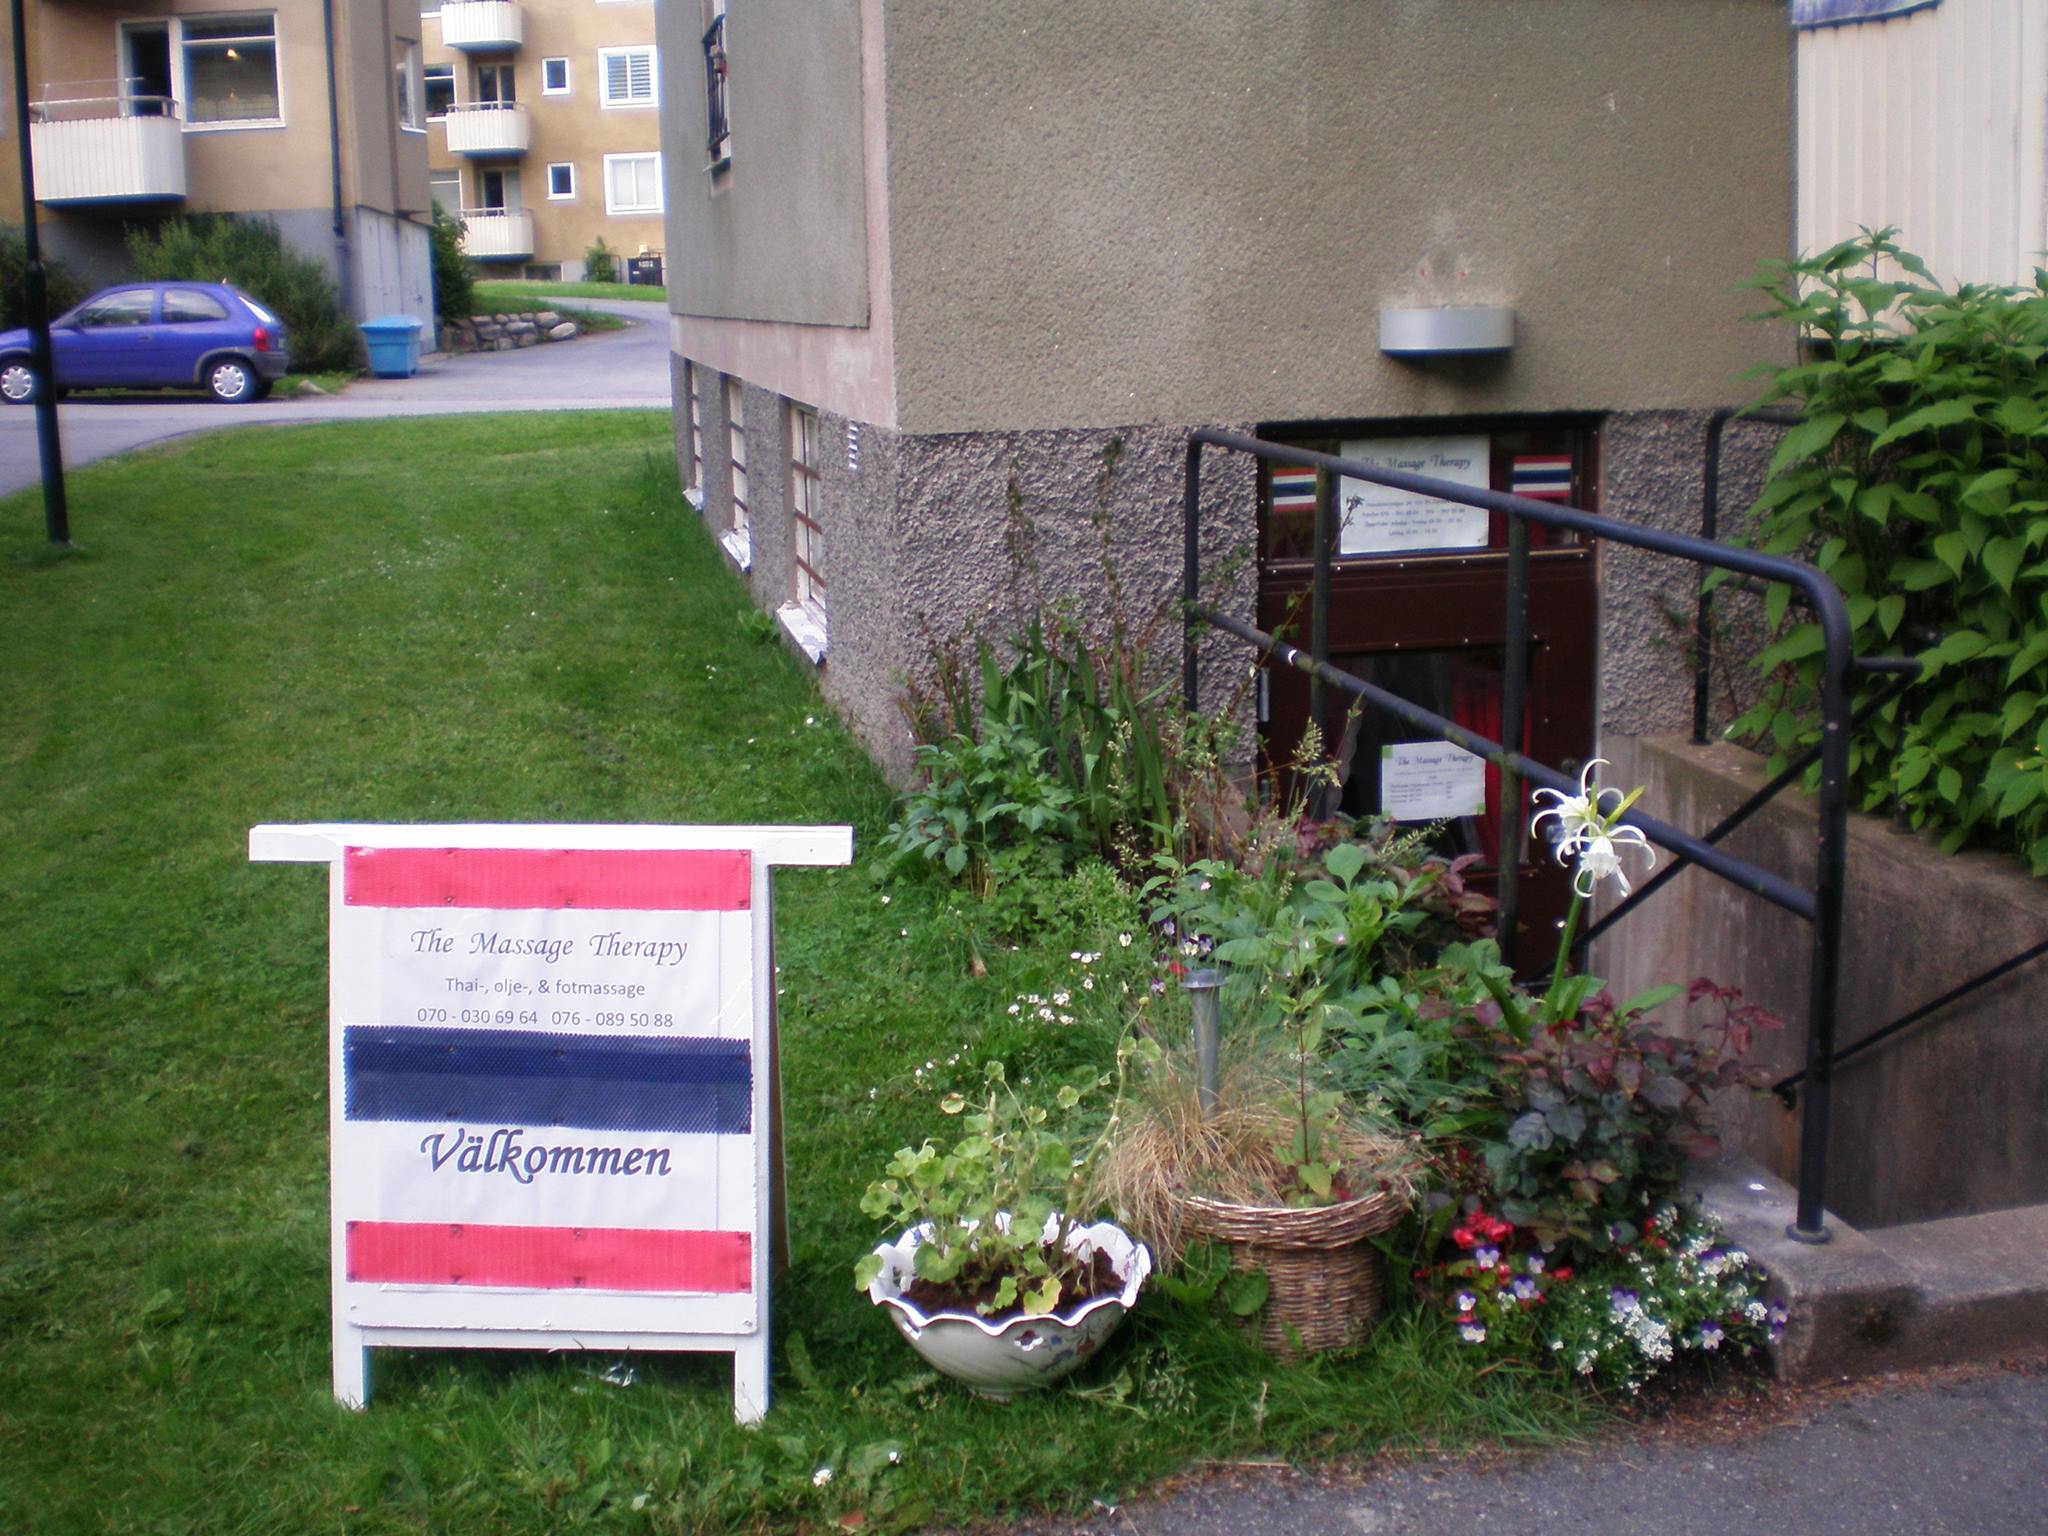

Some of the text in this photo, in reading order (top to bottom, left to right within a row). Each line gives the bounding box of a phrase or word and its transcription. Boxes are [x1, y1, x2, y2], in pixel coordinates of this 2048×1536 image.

[1430, 453, 1472, 470] Therapy
[410, 928, 688, 966] The Massage Therapy
[445, 978, 646, 998] Thai-, olje-, & fotmassage
[417, 1007, 447, 1022] 070
[461, 1009, 490, 1024] 030
[494, 1009, 515, 1025] 69
[518, 1010, 538, 1025] 64
[551, 1010, 581, 1025] 076
[595, 1012, 625, 1027] 089
[630, 1012, 649, 1028] 50
[653, 1013, 673, 1028] 88
[420, 1127, 673, 1185] Välkommen
